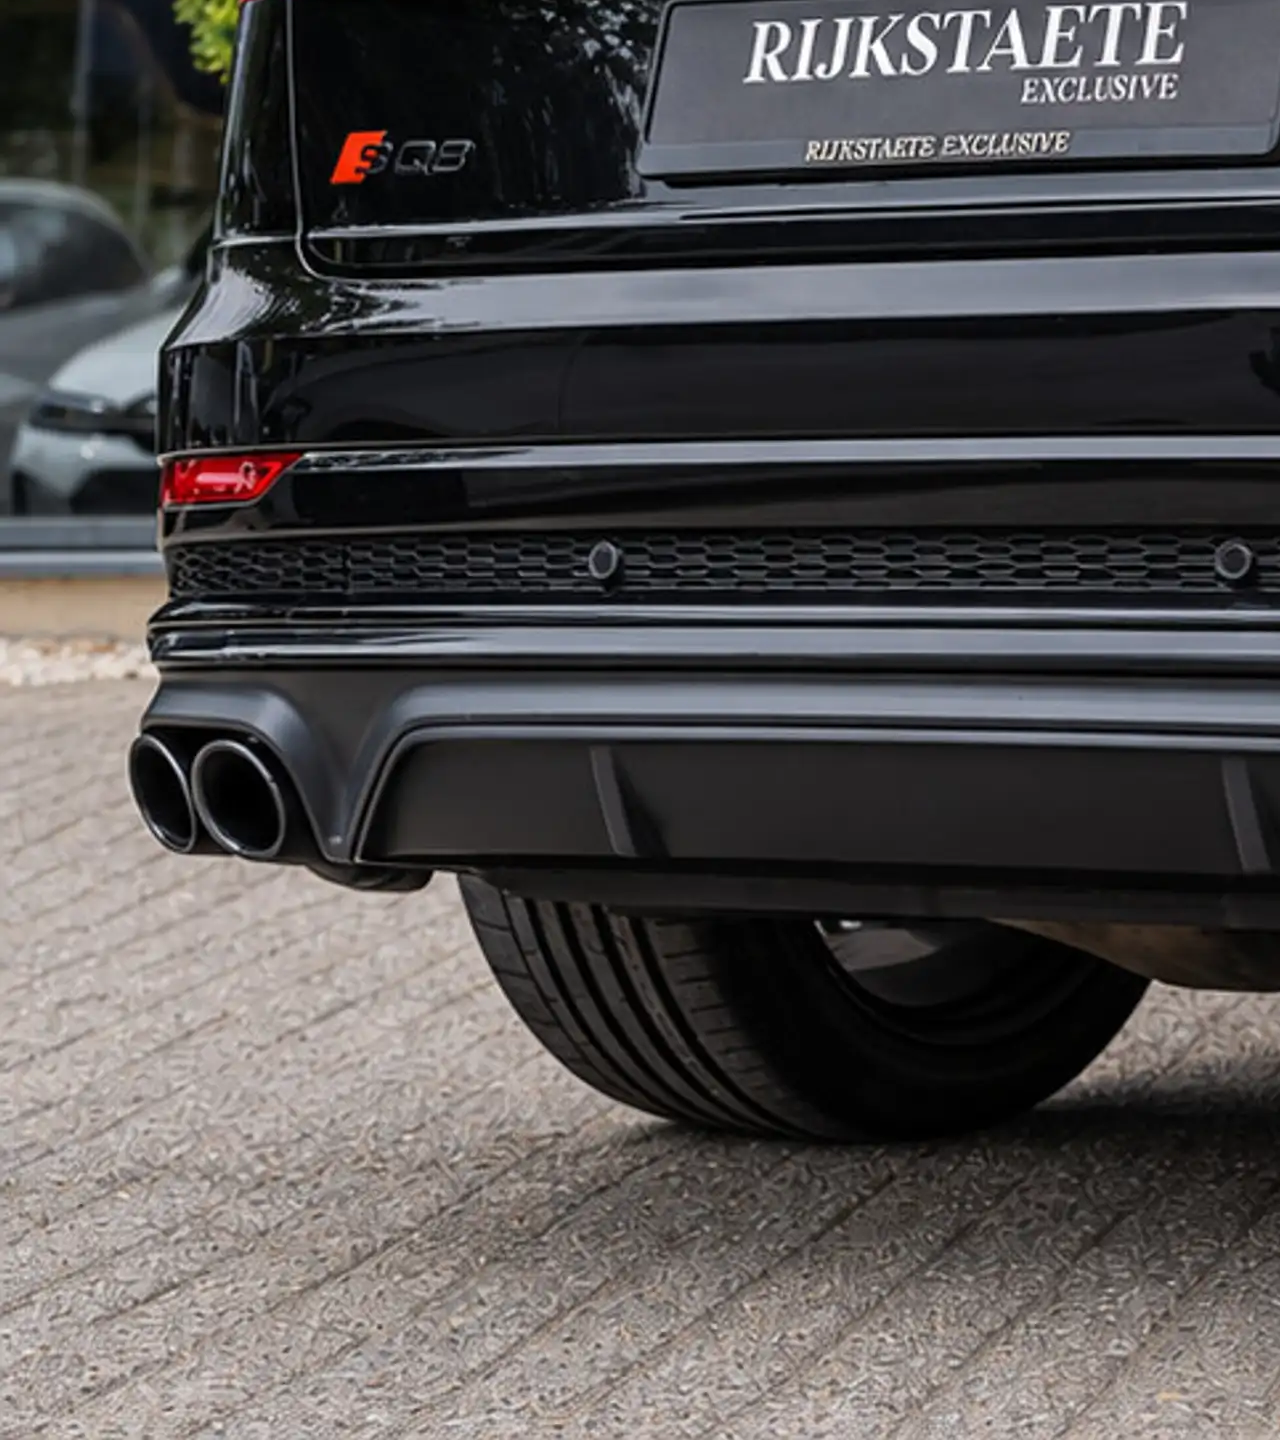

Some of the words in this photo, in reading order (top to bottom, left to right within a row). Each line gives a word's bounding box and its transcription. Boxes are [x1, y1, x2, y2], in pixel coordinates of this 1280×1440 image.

[743, 0, 1188, 83] RIJKSTAETE
[1020, 72, 1179, 105] EXCLUSIVE
[804, 136, 936, 161] RIJKSTAETE
[940, 130, 1071, 158] EXCLUSIVE
